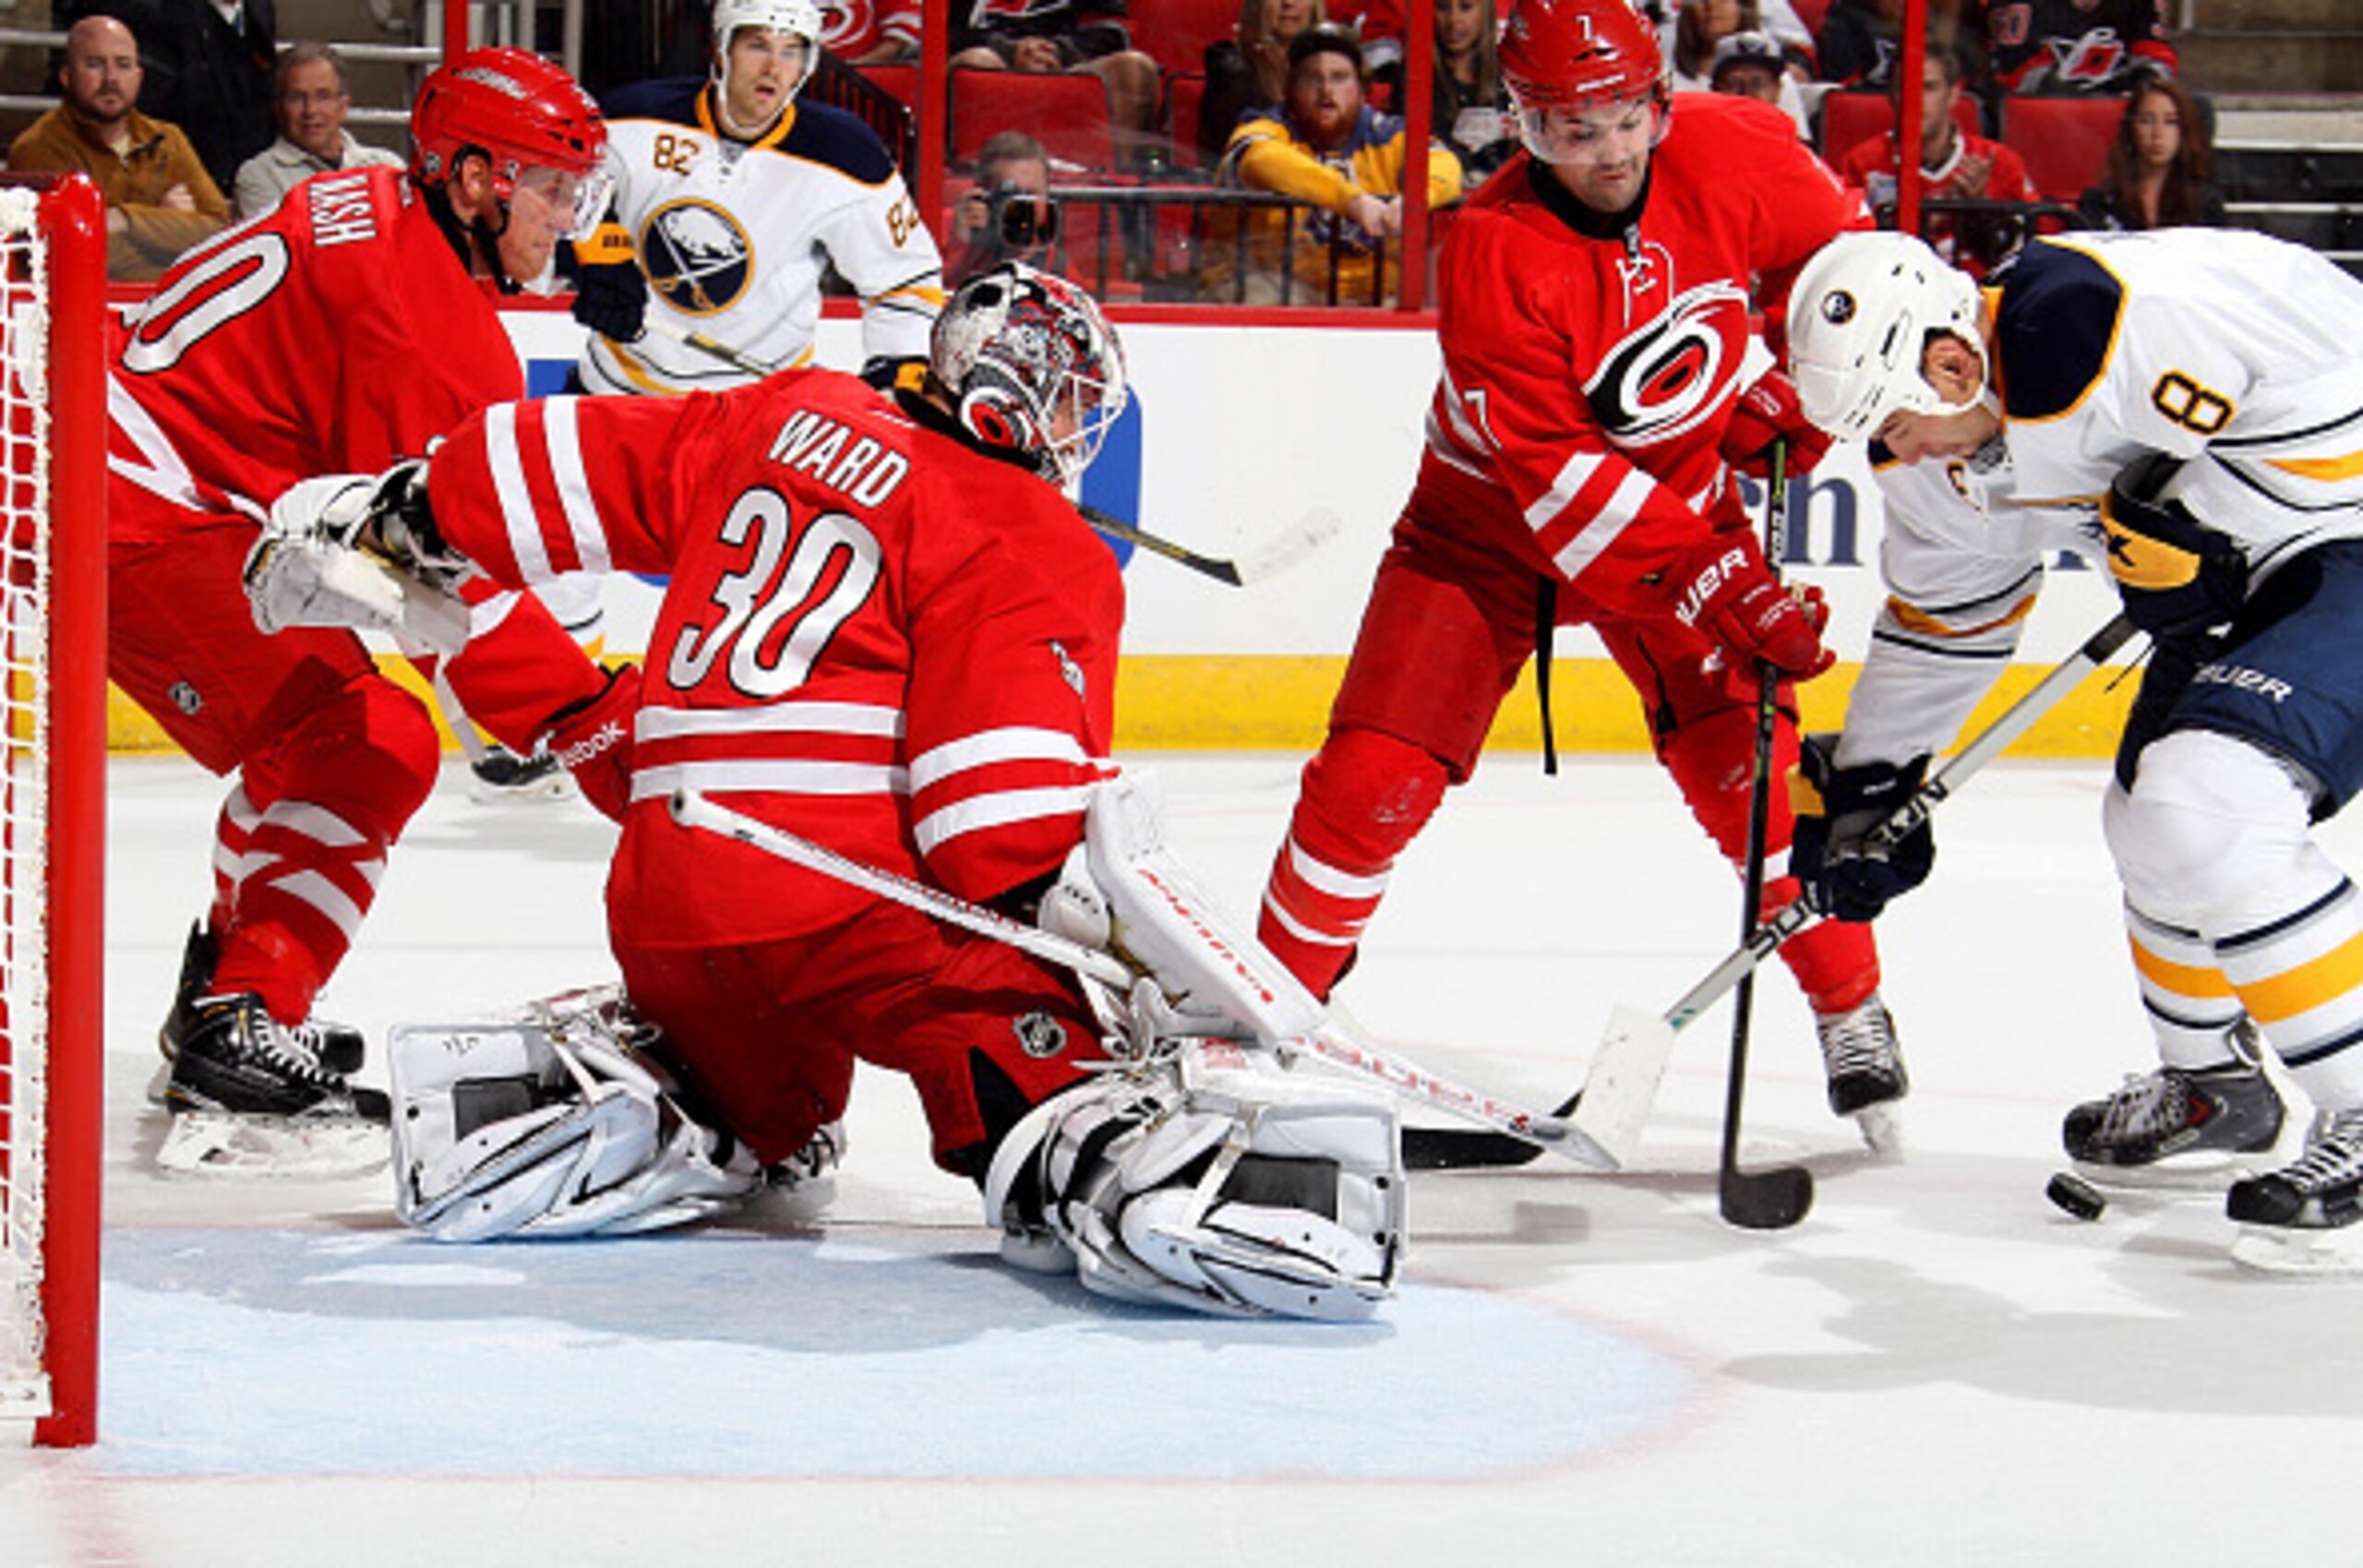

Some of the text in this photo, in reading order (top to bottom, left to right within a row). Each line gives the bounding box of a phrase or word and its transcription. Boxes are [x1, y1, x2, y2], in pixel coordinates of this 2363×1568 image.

[767, 409, 912, 509] WARD
[1463, 389, 1502, 451] 7
[666, 485, 882, 698] 30
